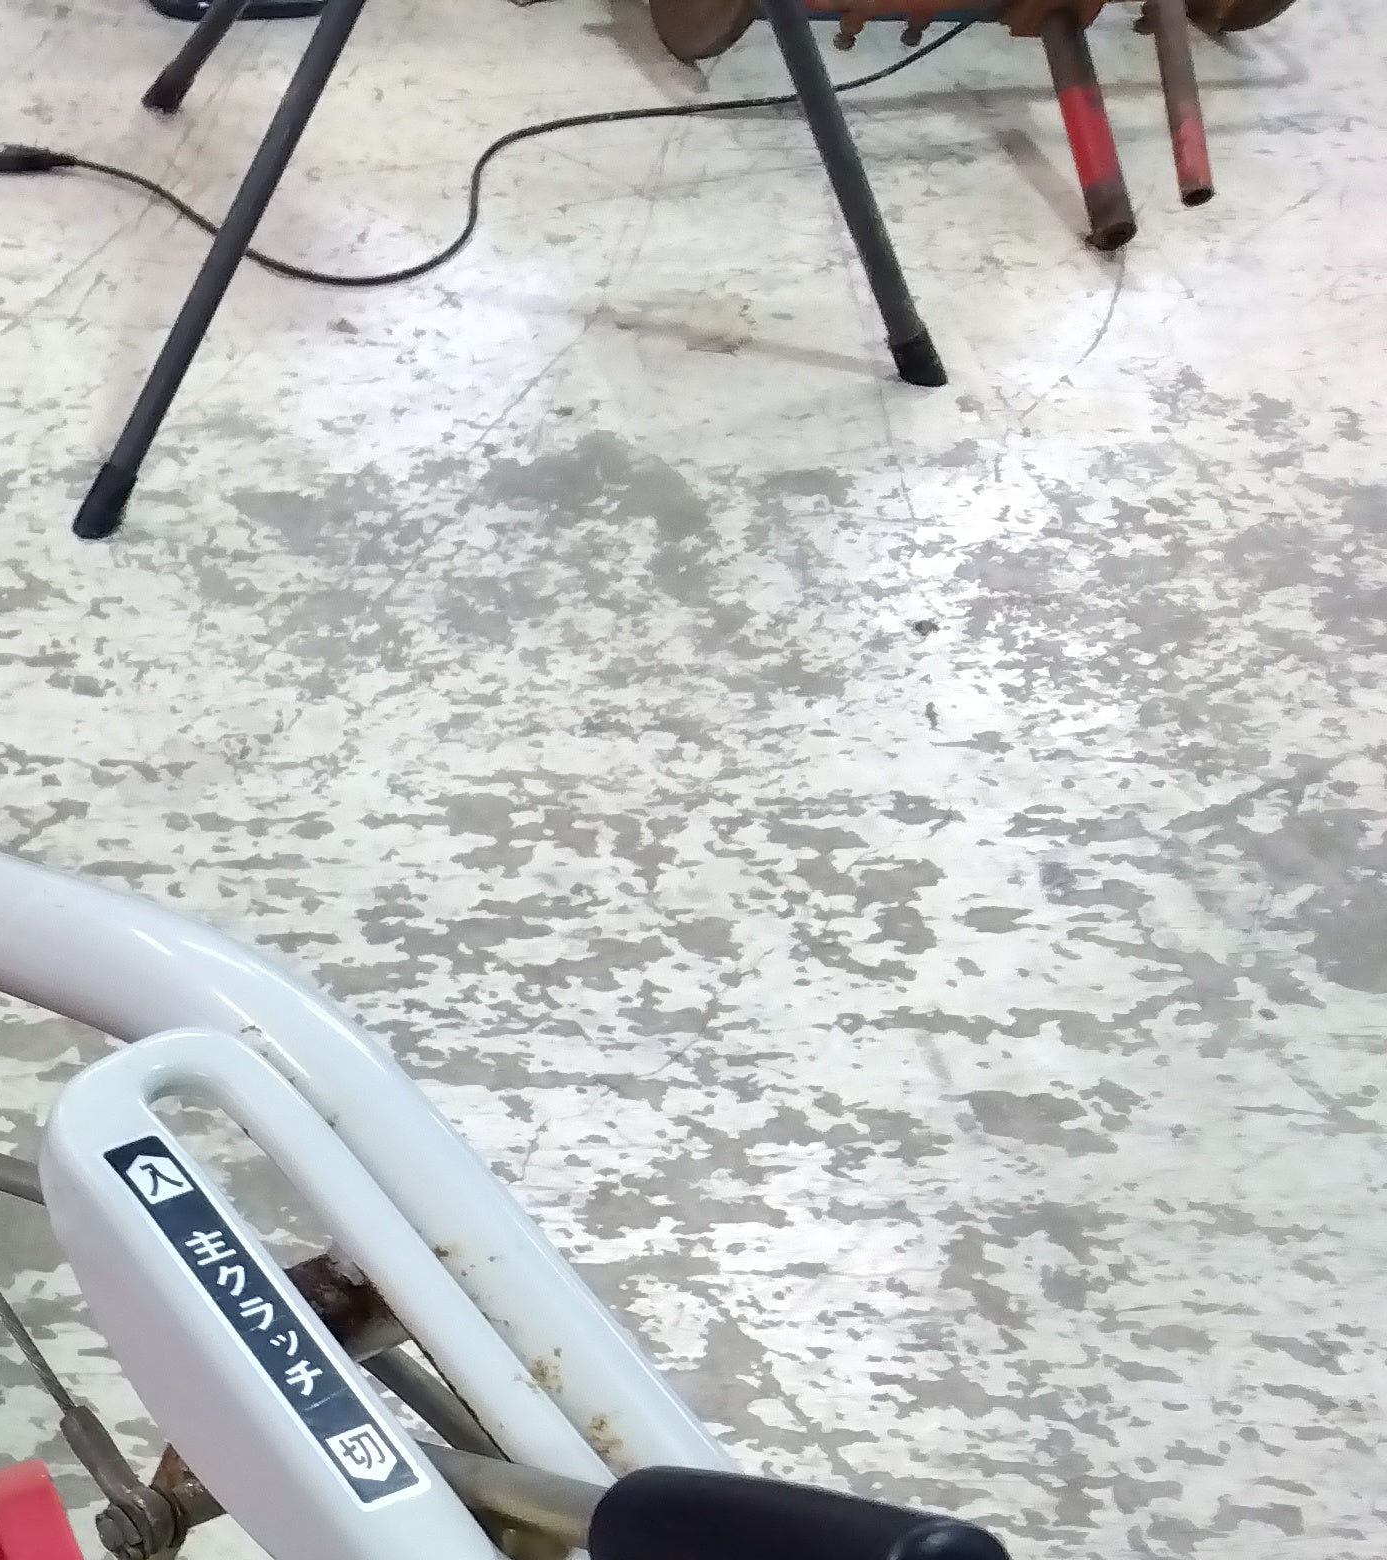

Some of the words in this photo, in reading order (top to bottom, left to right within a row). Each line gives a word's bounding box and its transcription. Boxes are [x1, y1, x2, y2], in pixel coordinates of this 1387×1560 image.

[138, 1162, 185, 1197] 入
[184, 1229, 324, 1397] 主クラッチ
[341, 1431, 387, 1471] 切
